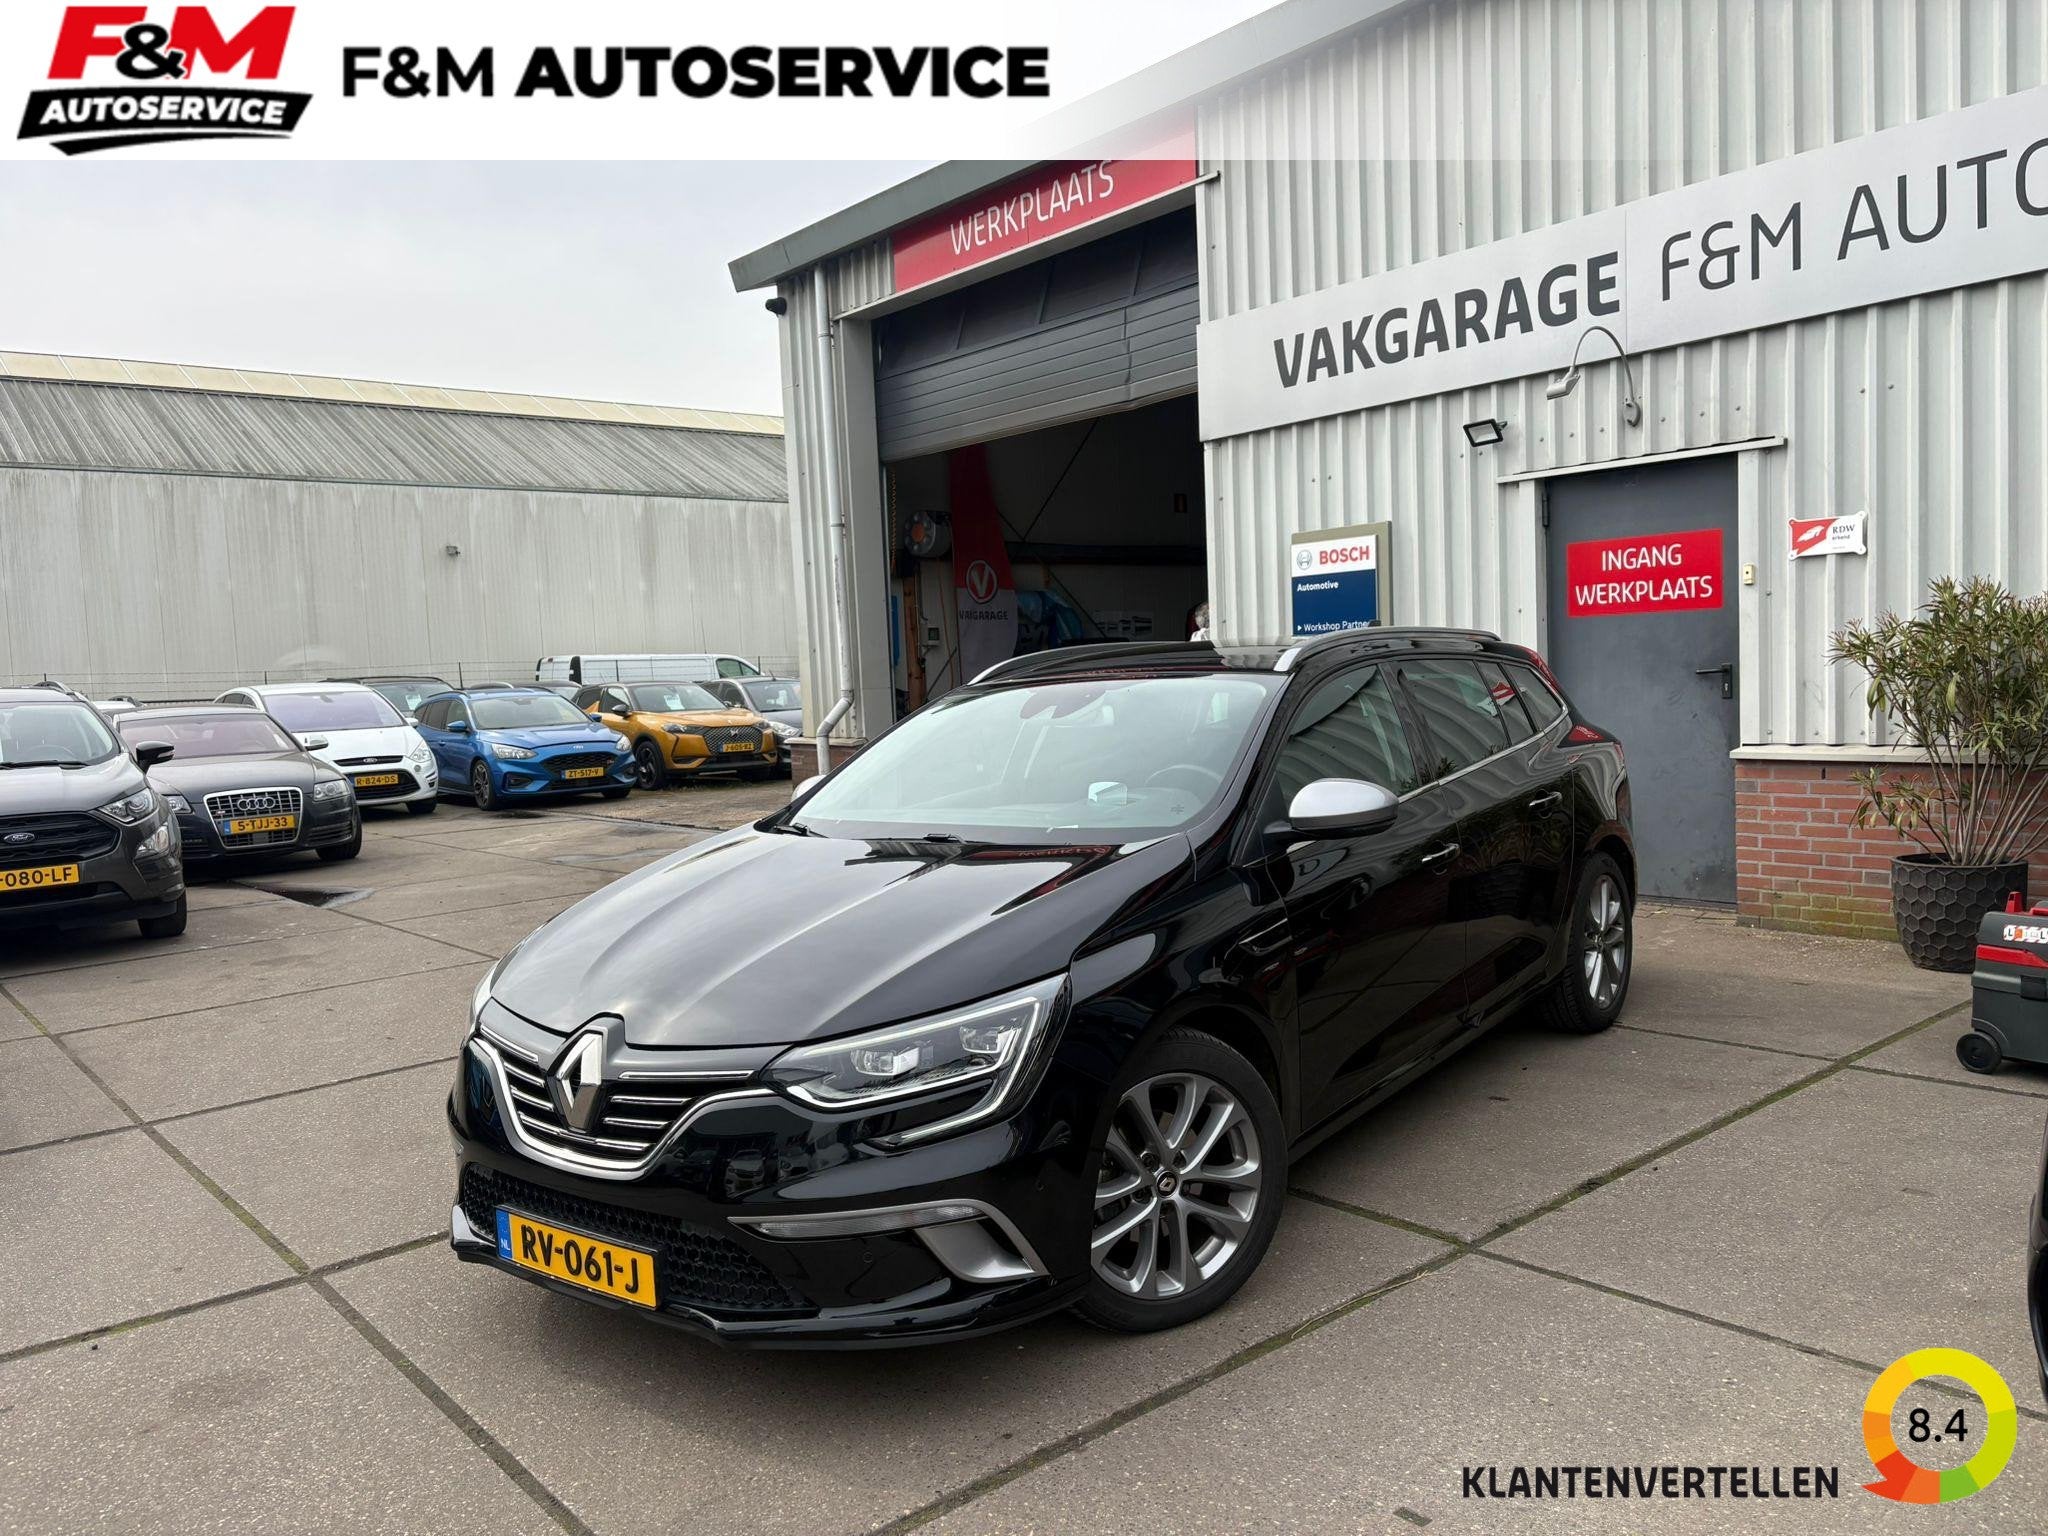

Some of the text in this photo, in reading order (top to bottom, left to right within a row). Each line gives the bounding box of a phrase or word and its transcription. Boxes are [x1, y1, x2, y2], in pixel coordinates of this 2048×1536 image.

[950, 160, 1114, 256] WERKPLAATS
[1273, 251, 1620, 388] VAKGARAGE
[1661, 202, 1801, 301] F&M
[1832, 524, 1855, 534] RDW
[1319, 546, 1370, 565] BOSCH
[1601, 543, 1682, 571] INGANG
[1297, 581, 1339, 592] Automotive
[1575, 575, 1713, 606] WERKPLAATS
[1304, 621, 1340, 632] Workshop
[237, 817, 288, 831] 5-TJJ-33
[520, 1224, 639, 1294] RV-061-J
